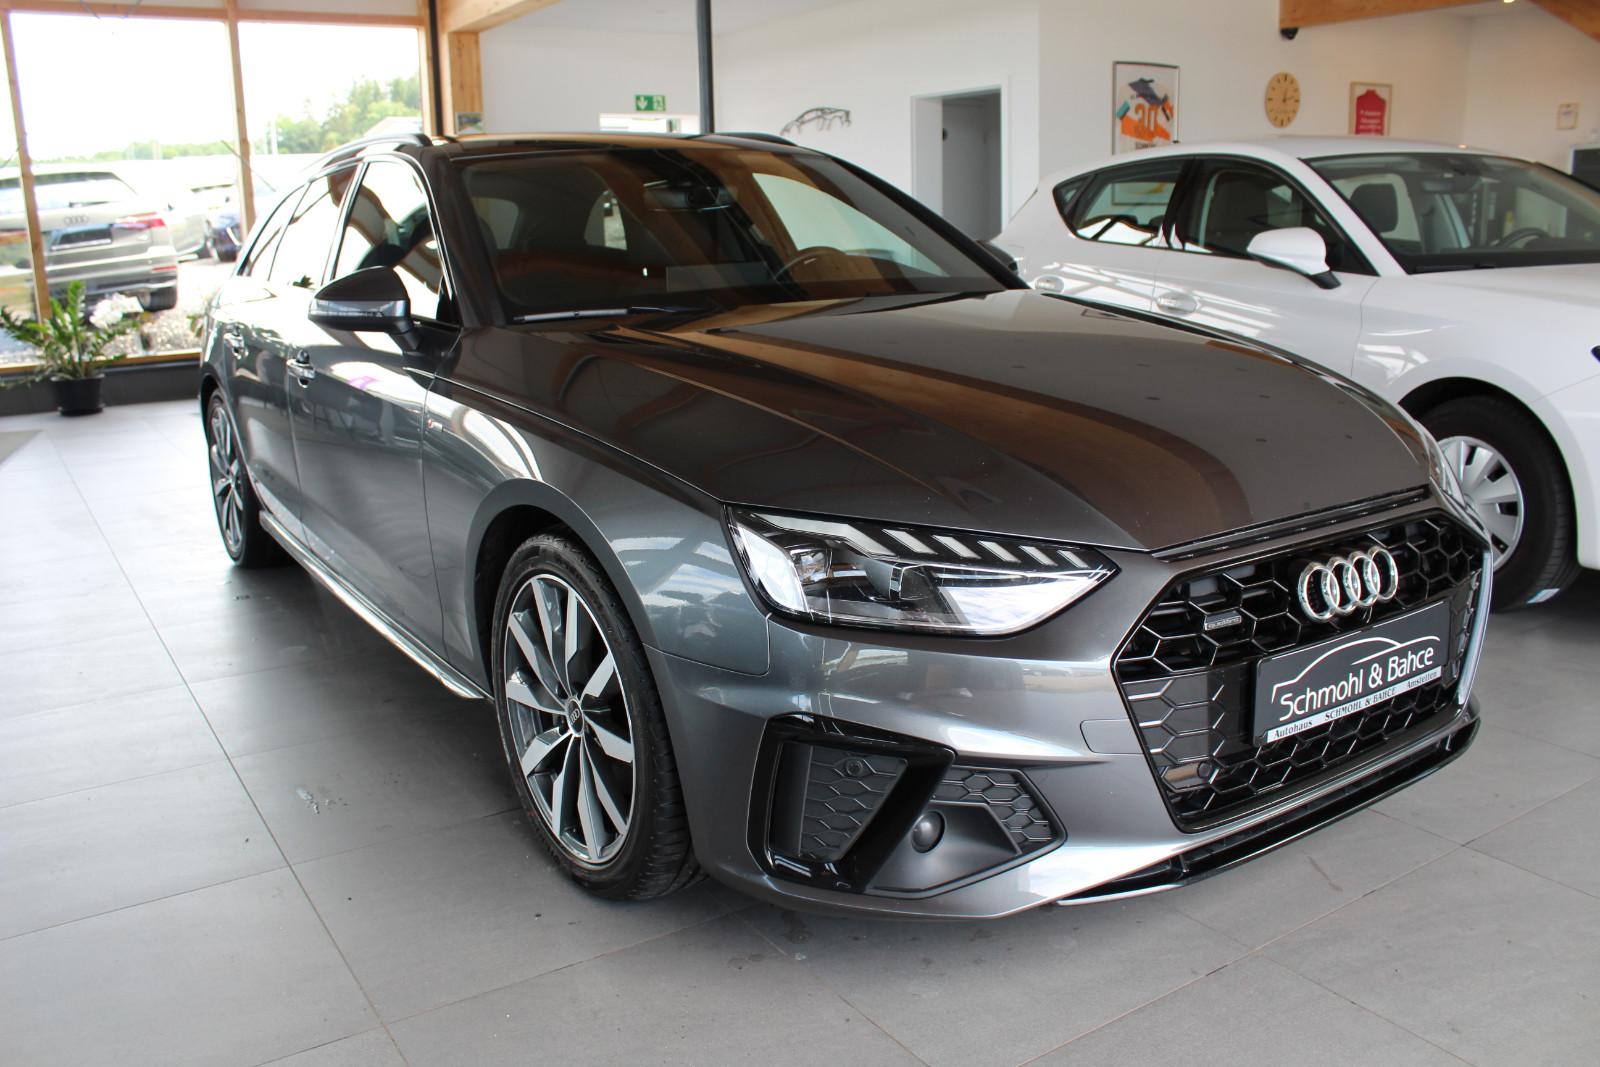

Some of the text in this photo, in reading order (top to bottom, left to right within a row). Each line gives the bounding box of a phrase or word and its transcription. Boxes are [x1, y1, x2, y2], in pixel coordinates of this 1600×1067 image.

[1279, 647, 1434, 722] Schmohl & Bahce
[1275, 720, 1313, 738] Autohaus
[1325, 700, 1362, 720] SCHMOHL
